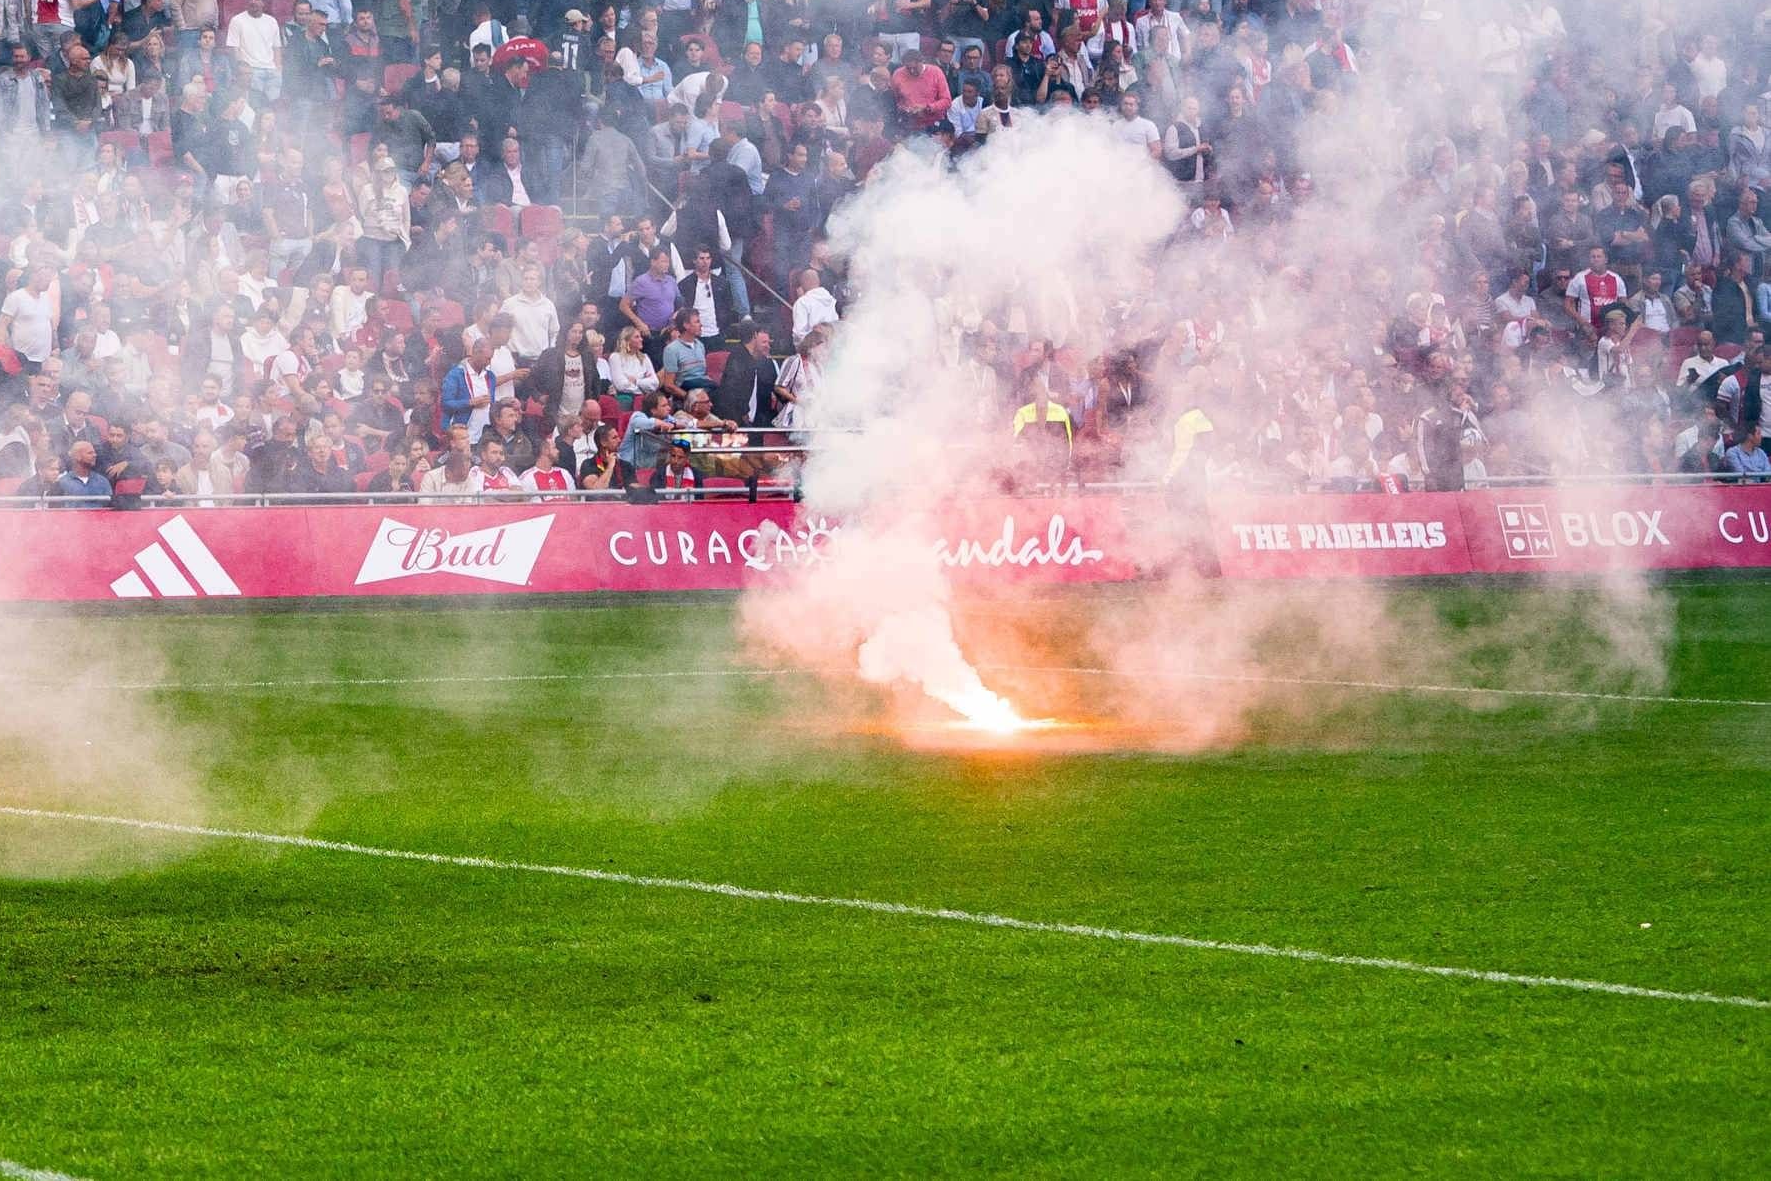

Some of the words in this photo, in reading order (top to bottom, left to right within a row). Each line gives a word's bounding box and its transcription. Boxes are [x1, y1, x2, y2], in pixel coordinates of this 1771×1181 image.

[931, 514, 1104, 568] andals
[1232, 523, 1291, 550] THE
[1297, 521, 1447, 549] PADELLERS
[1560, 510, 1670, 548] BLOX
[1718, 511, 1769, 544] CU
[386, 527, 509, 571] Bud
